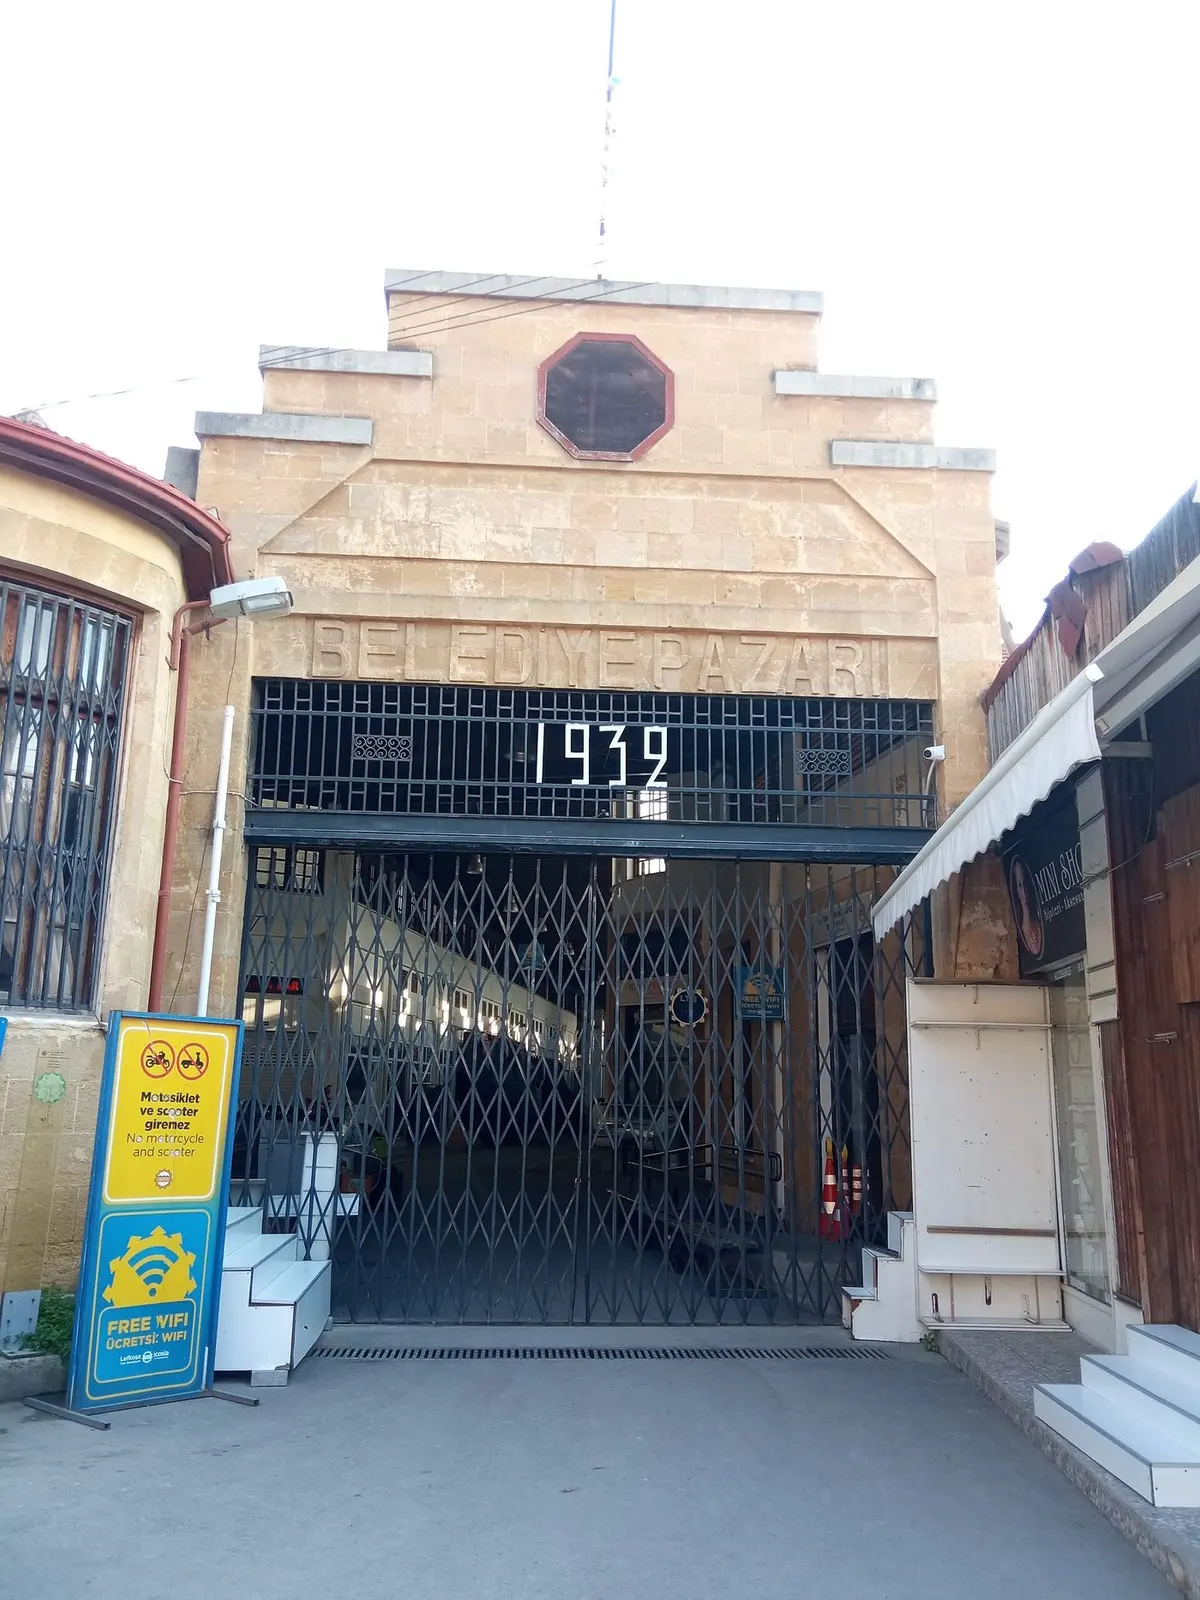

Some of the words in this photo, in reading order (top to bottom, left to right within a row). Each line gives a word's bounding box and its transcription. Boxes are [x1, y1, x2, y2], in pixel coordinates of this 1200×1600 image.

[1034, 861, 1061, 905] MINI
[140, 1091, 200, 1104] Motosiklet
[140, 1107, 154, 1116] ve
[156, 1106, 199, 1117] scooter
[144, 1119, 191, 1131] giremez
[126, 1133, 143, 1144] No
[146, 1133, 204, 1145] motorcycle
[132, 1147, 155, 1157] and
[157, 1147, 196, 1157] scooter
[107, 1316, 152, 1336] FREE
[155, 1312, 189, 1329] WIFI
[161, 1330, 187, 1343] WIFI
